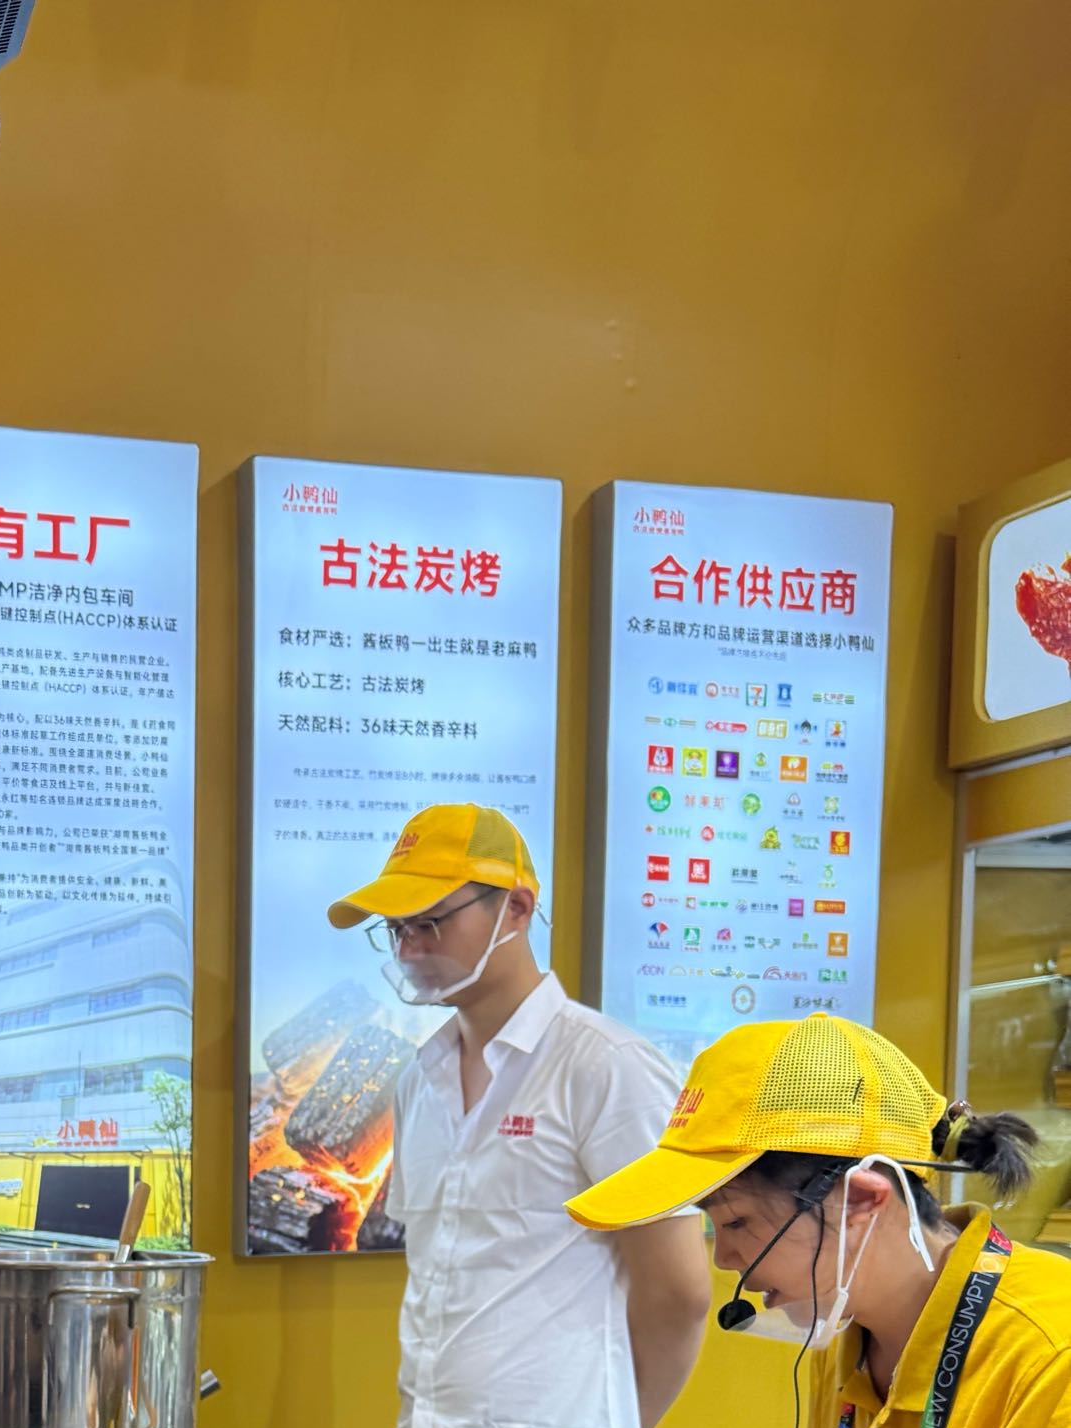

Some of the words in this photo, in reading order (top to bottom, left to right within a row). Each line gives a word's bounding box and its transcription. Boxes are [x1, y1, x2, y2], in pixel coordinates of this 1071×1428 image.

[283, 482, 338, 505] 小鸭仙
[633, 507, 685, 527] 小鸭仙
[319, 537, 502, 598] 古法炭烤
[650, 555, 858, 616] 合作供应商
[626, 616, 875, 652] 众多品牌方和品牌运营渠道选择小鸭仙
[57, 1117, 118, 1140] 小鸭仙
